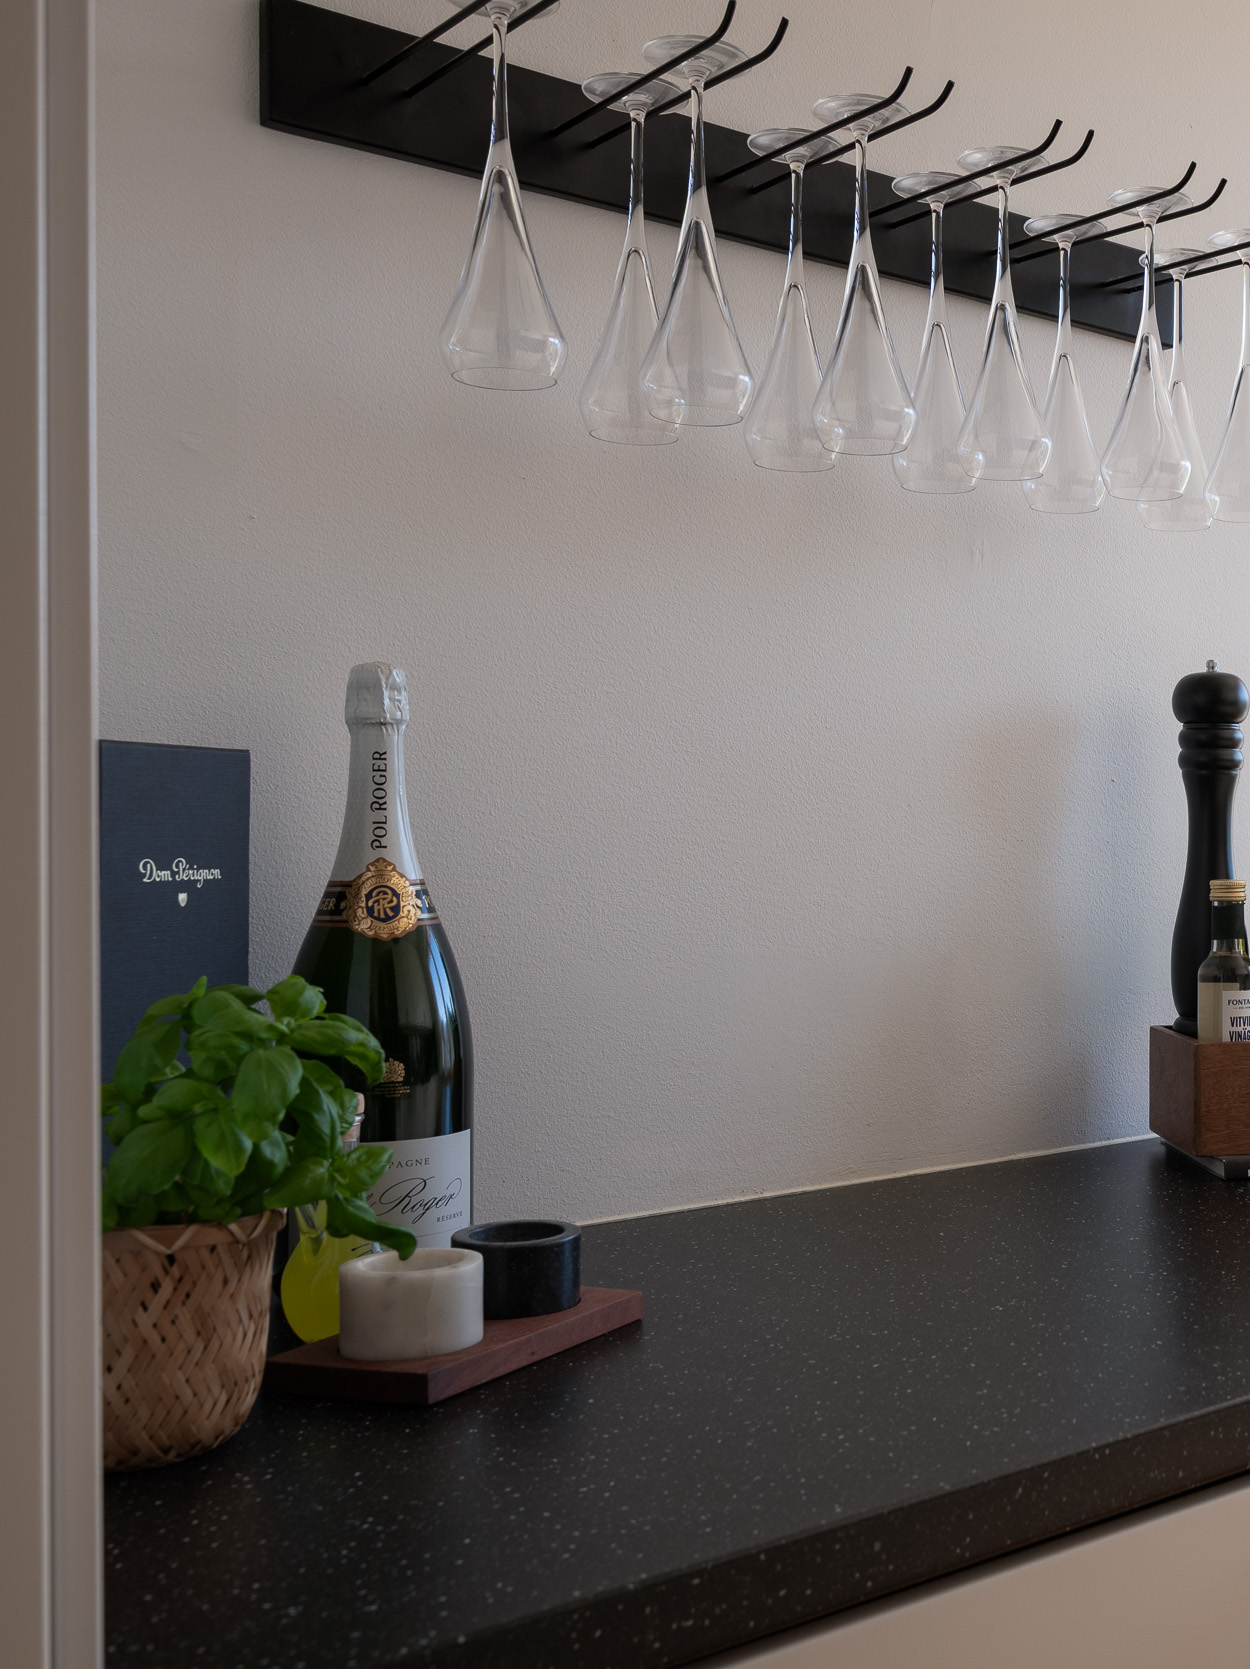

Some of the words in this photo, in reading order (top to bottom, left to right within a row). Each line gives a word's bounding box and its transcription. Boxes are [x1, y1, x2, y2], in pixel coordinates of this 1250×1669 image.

[370, 750, 388, 812] ROGER
[370, 815, 388, 850] POL
[139, 858, 173, 882] Dom
[172, 857, 222, 888] Pérignon
[319, 898, 337, 910] GER
[388, 1157, 430, 1169] PAGNE
[376, 1176, 463, 1225] Roger
